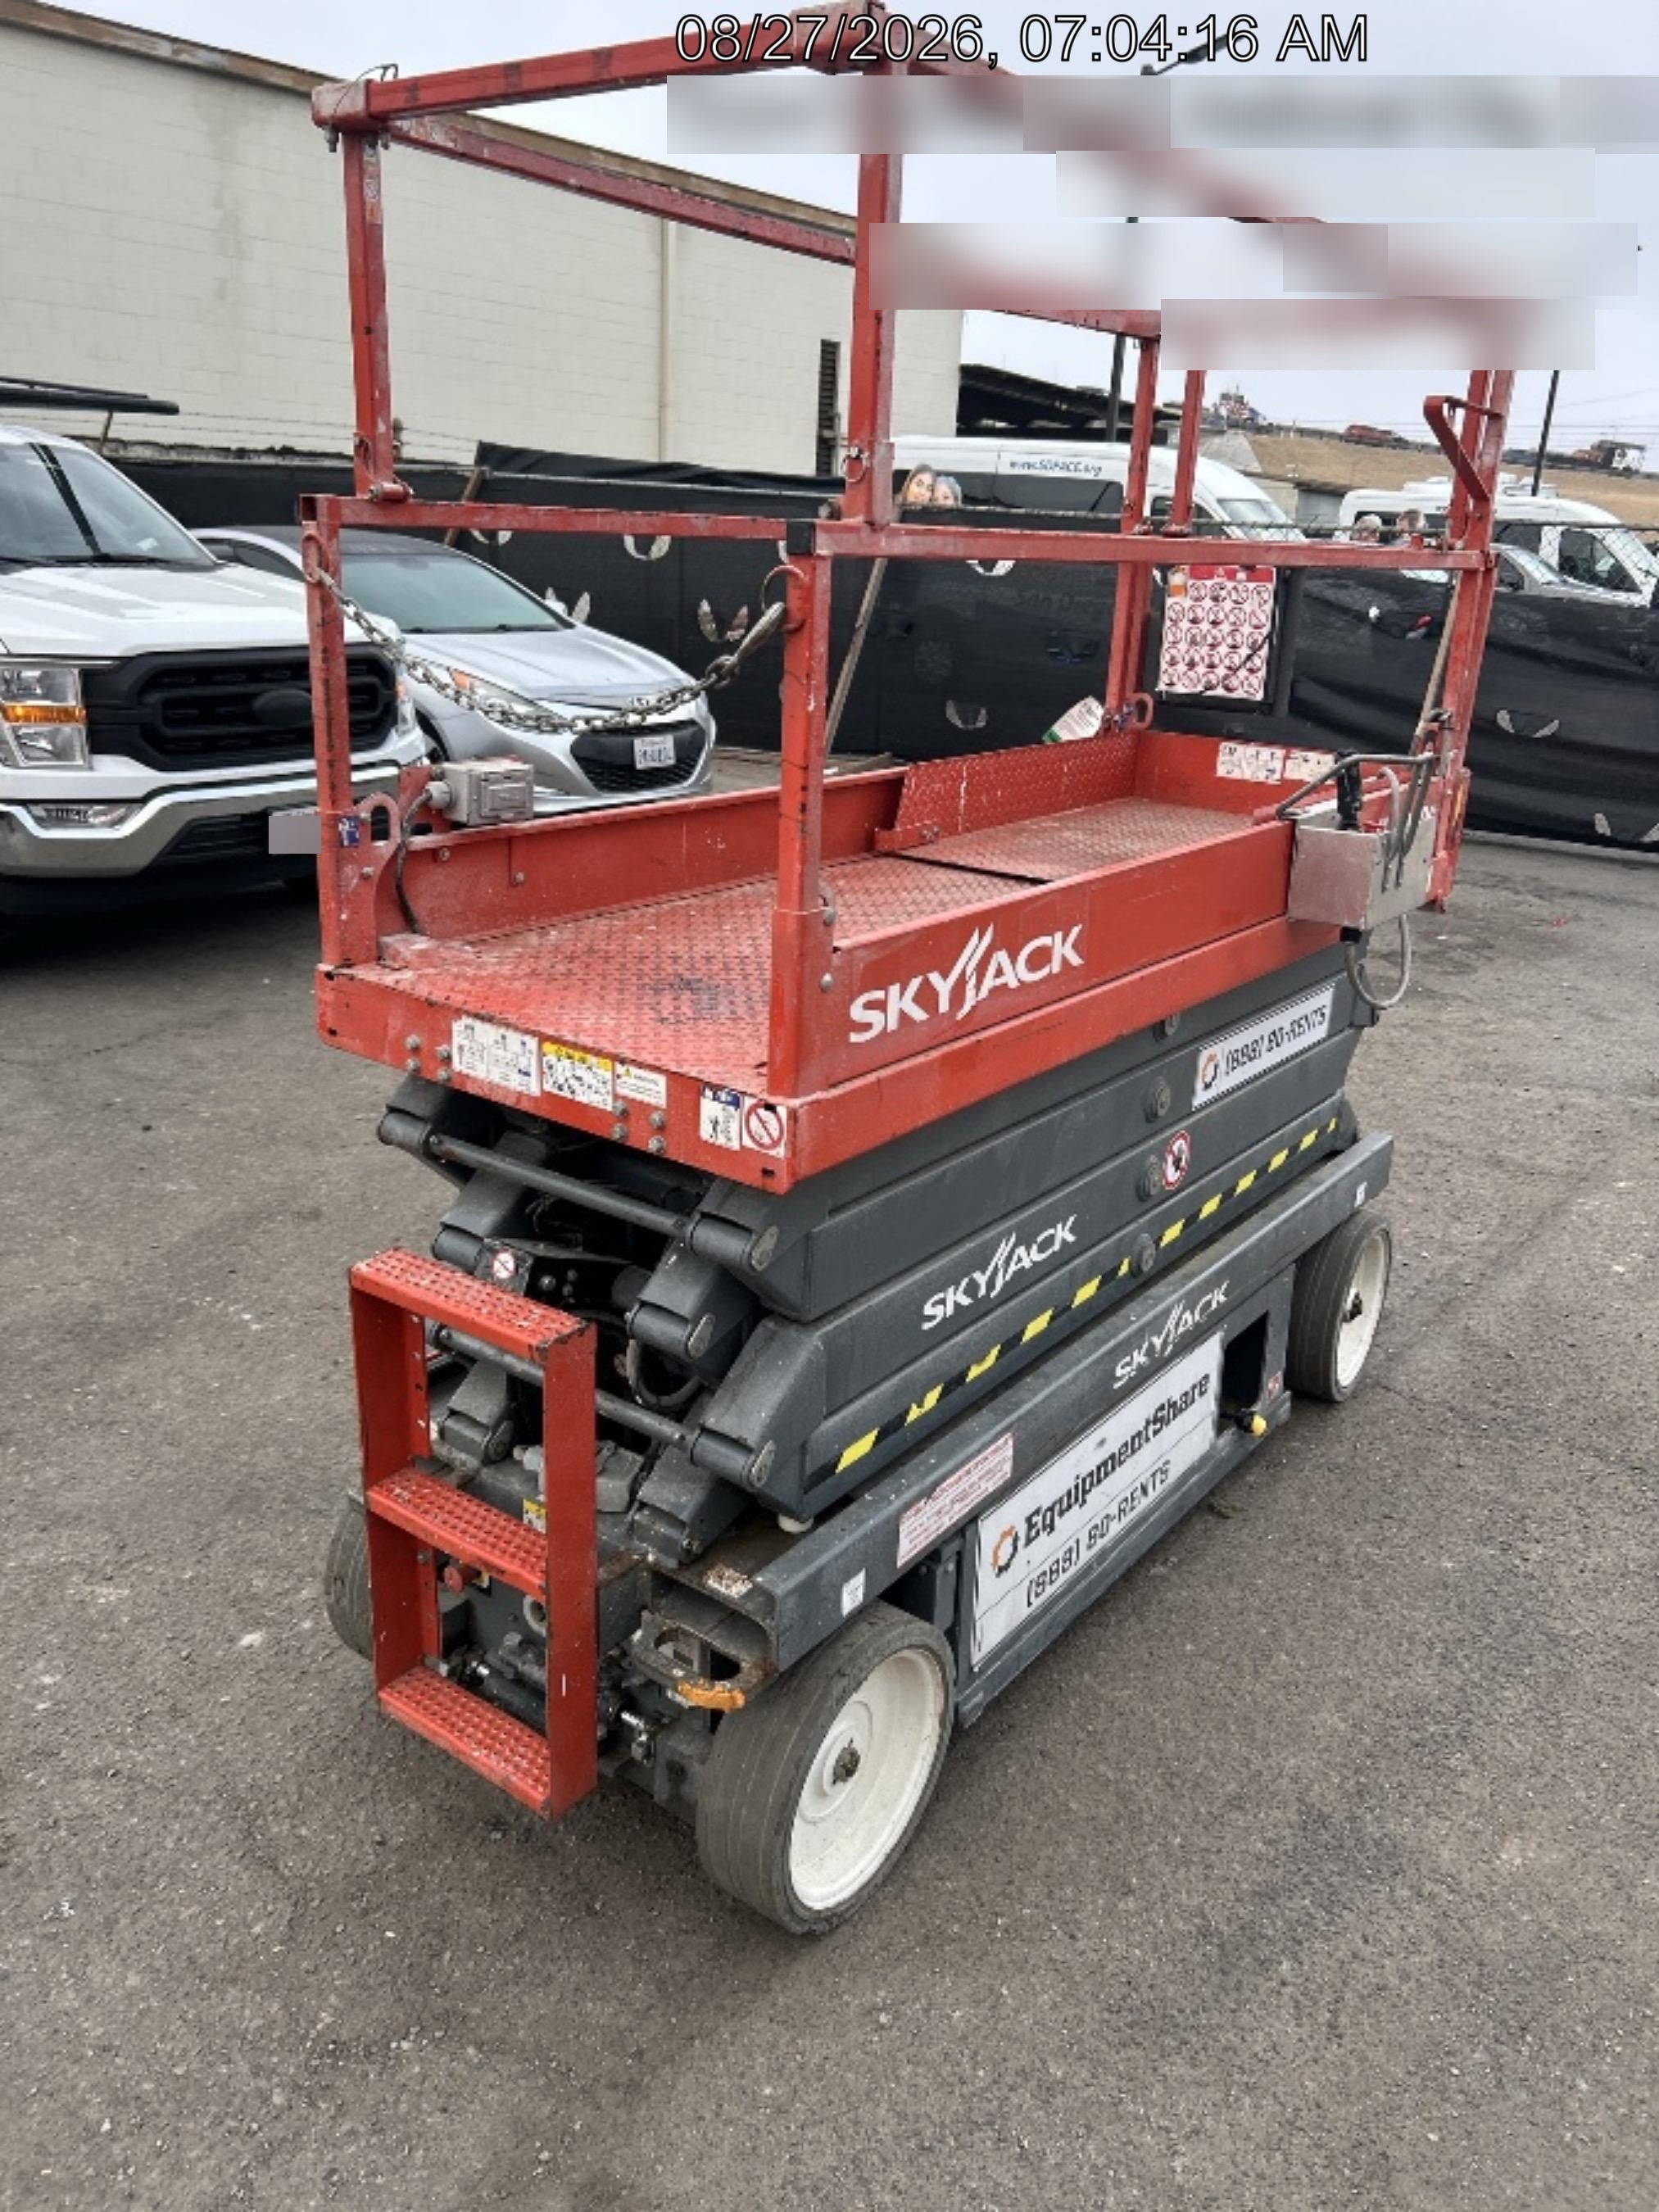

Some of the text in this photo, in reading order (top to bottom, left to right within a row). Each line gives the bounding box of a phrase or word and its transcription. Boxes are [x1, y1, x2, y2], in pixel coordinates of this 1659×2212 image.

[849, 922, 1086, 1043] SKYJACK
[921, 1213, 1078, 1331] SKYJACK
[1113, 1280, 1231, 1389] SKYJACK
[1024, 1373, 1211, 1549] EquipmentShare
[1027, 1537, 1081, 1608] (888)
